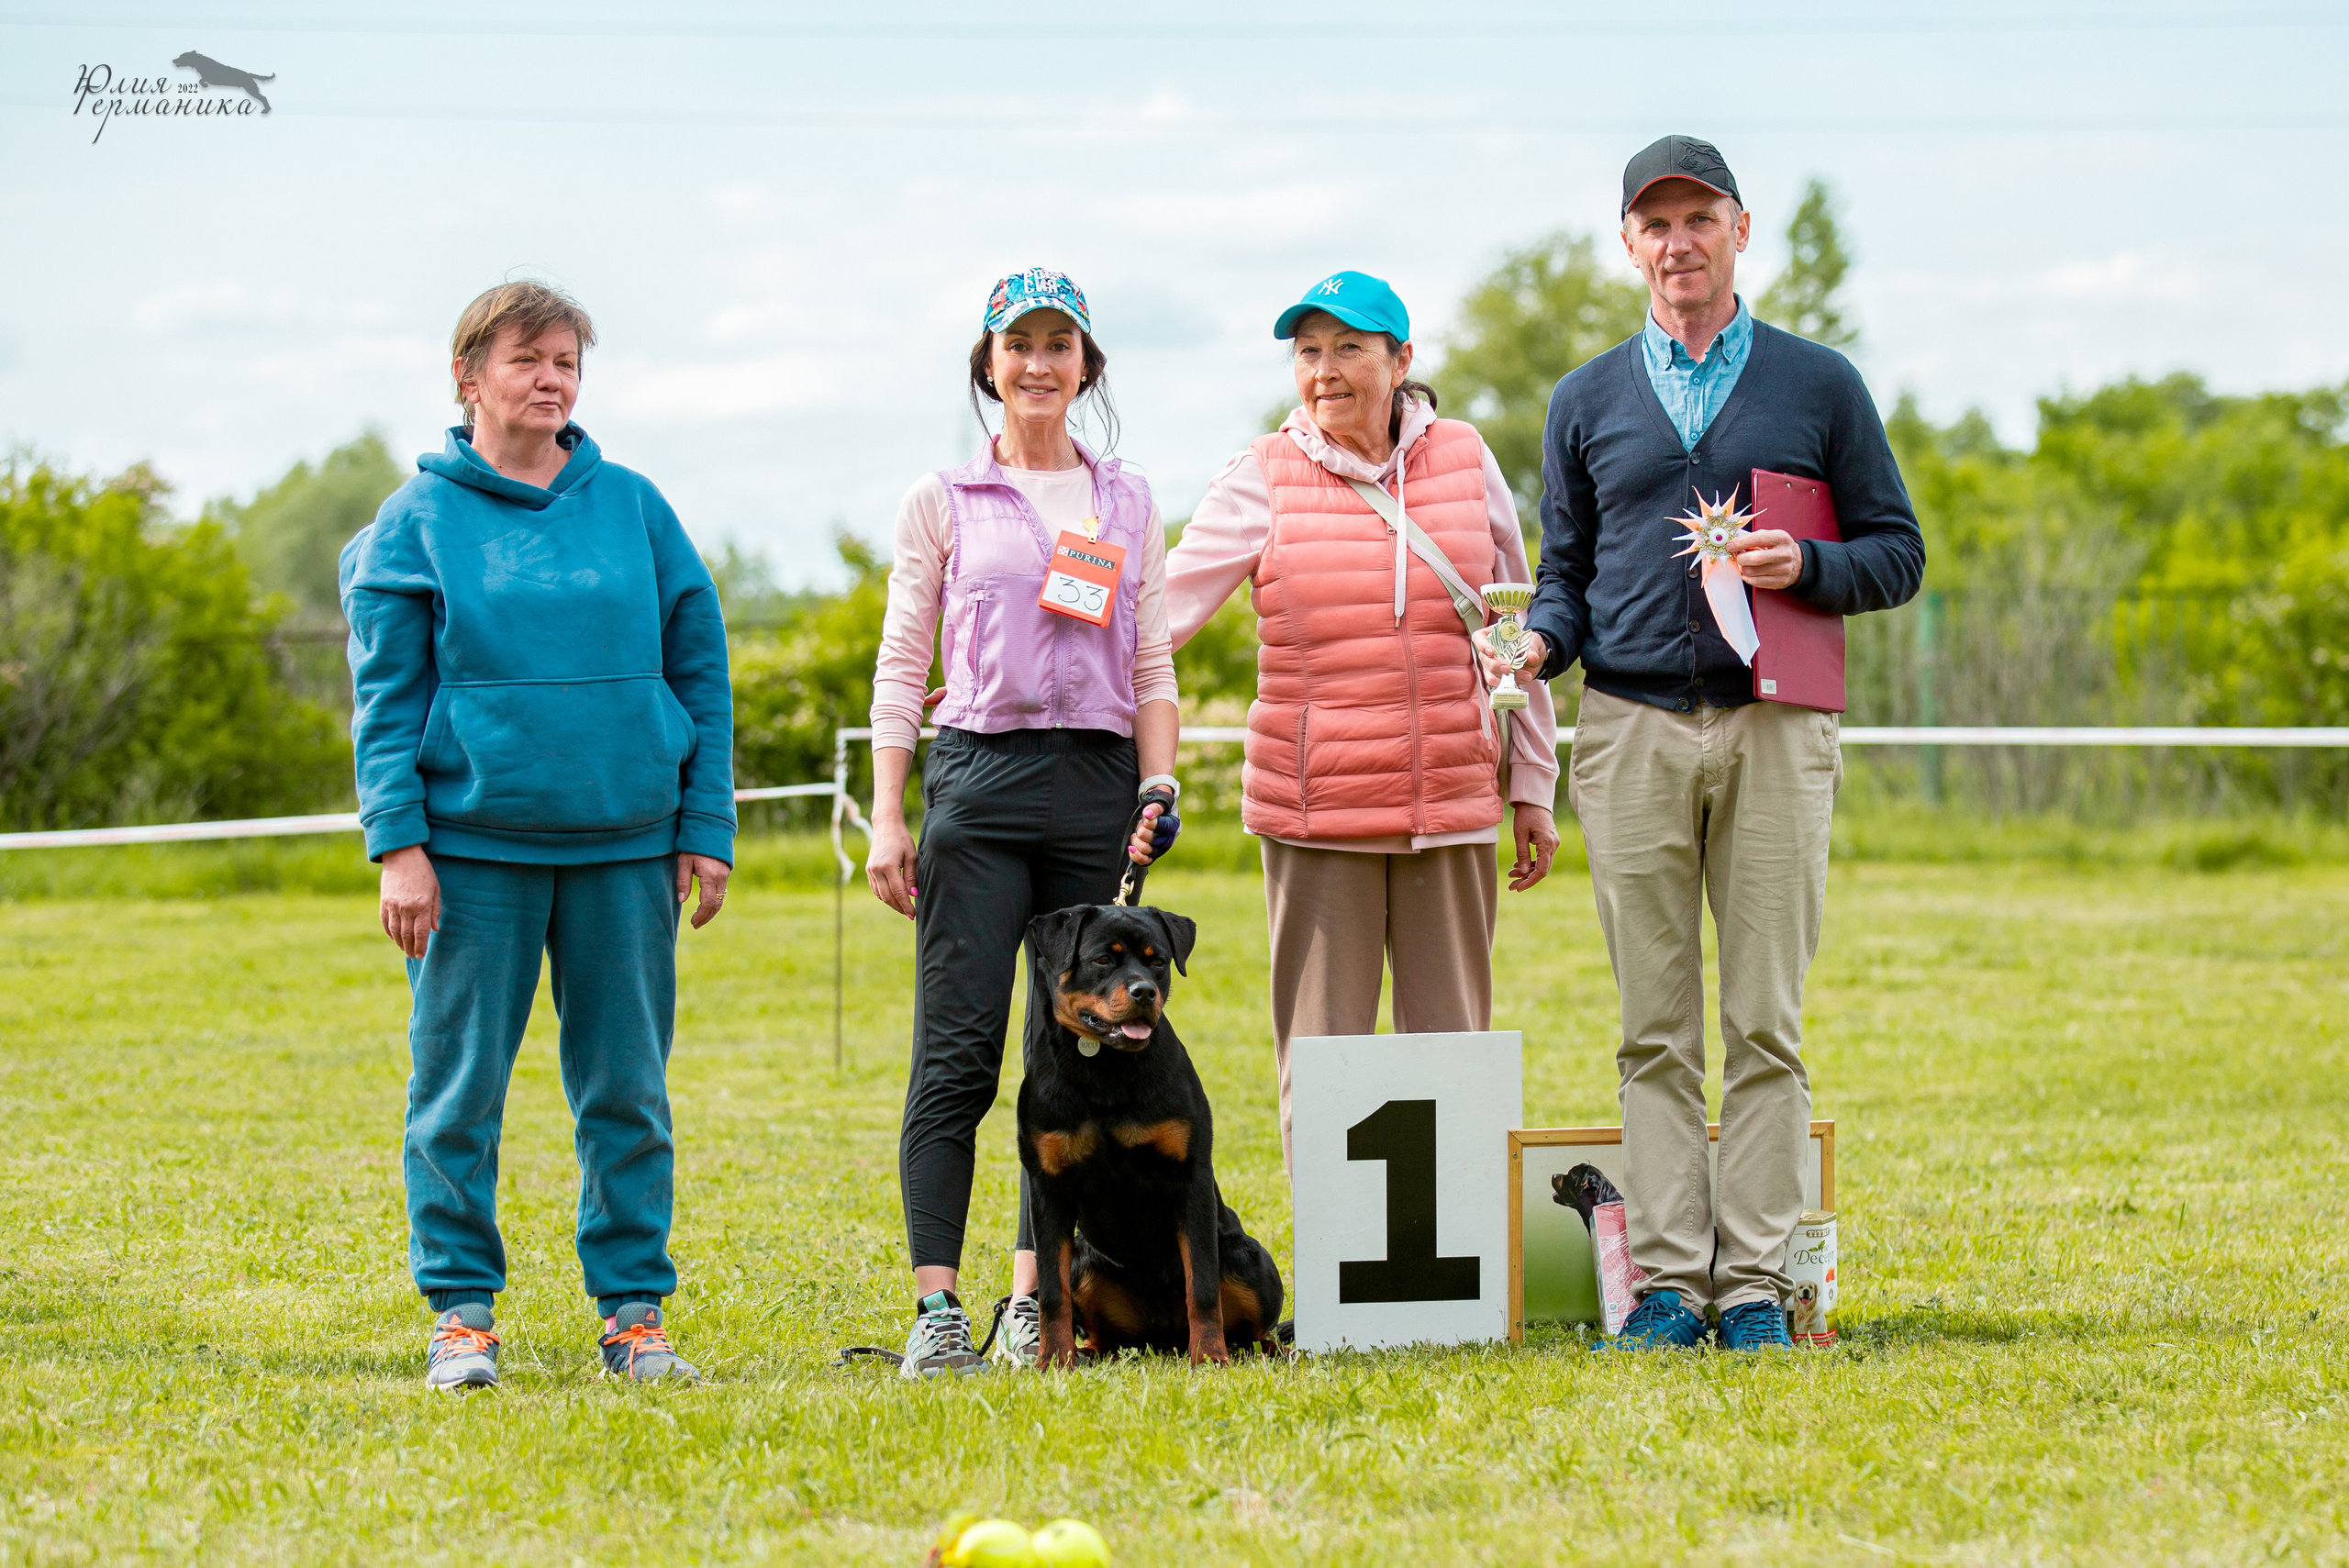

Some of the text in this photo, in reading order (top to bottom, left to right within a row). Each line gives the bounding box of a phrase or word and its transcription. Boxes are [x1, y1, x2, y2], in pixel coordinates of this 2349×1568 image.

[1024, 279, 1058, 294] СИЯ
[1318, 278, 1344, 295] NY
[1068, 549, 1114, 570] PURINA
[1057, 576, 1104, 612] 33
[1339, 1098, 1481, 1305] 1
